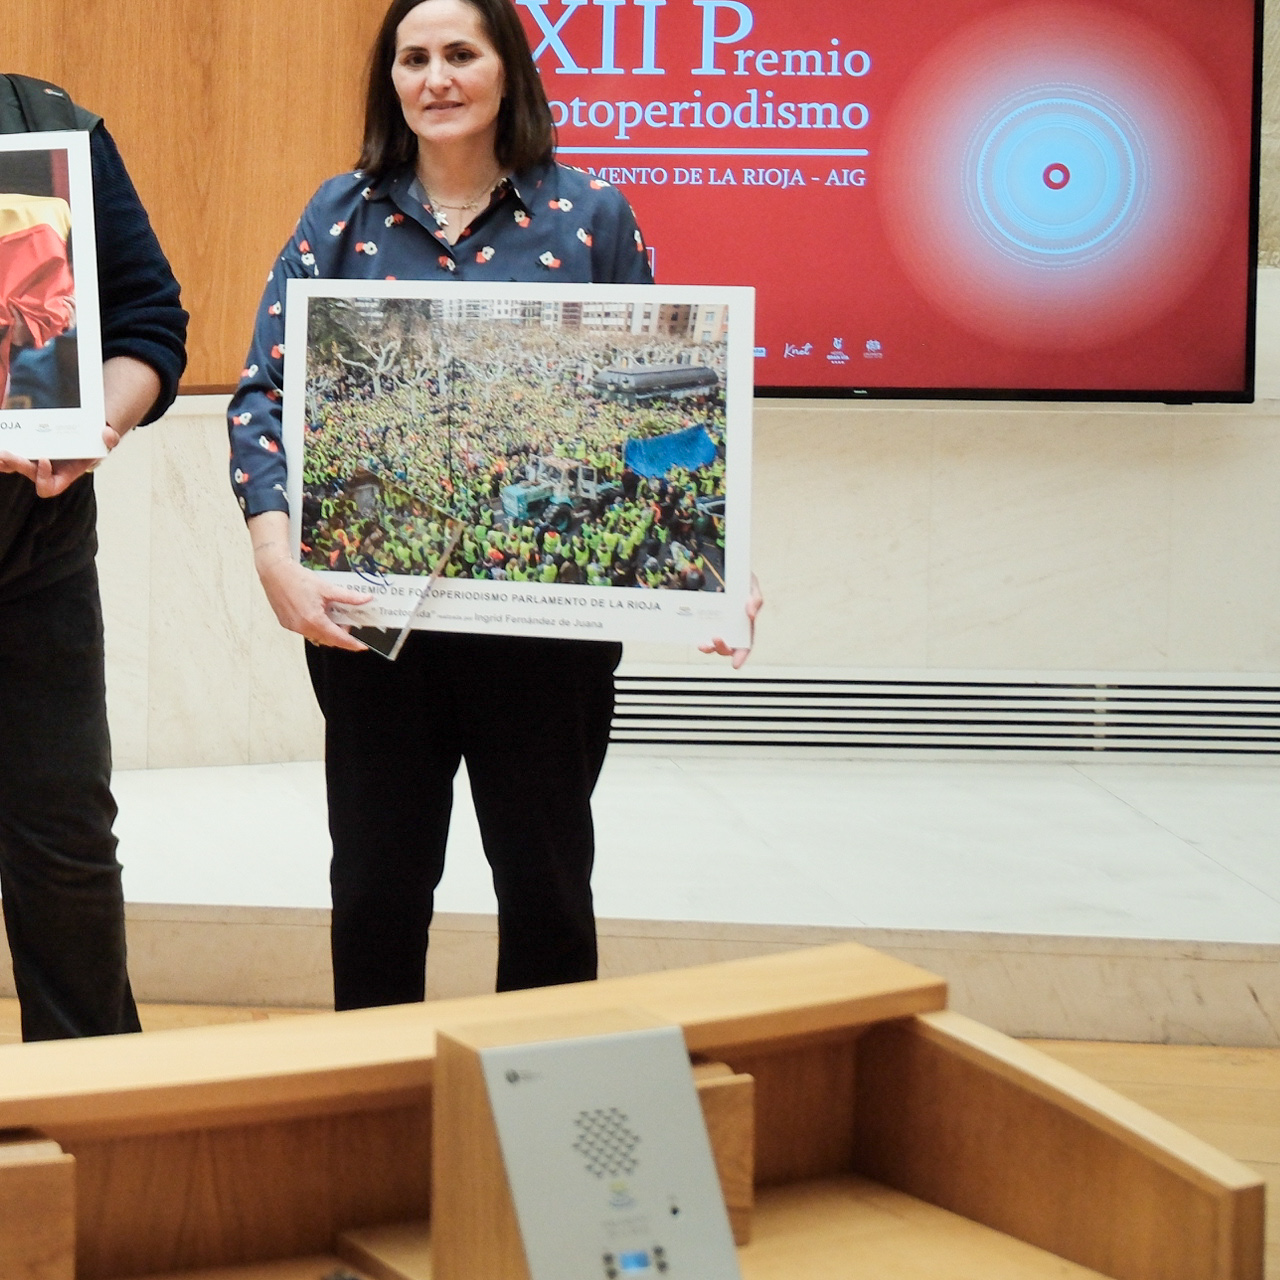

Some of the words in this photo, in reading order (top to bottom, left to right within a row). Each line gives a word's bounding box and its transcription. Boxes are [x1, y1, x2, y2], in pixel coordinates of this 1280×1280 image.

[515, 0, 667, 75] XII
[691, 0, 871, 76] Premio
[549, 89, 870, 140] otoperiodismo
[587, 167, 668, 185] MENTO
[673, 167, 702, 185] DE
[709, 168, 735, 186] LA
[742, 168, 806, 189] RIOJA
[825, 169, 866, 186] AIG
[391, 588, 404, 596] DE
[512, 595, 586, 606] PARLAMENTO
[591, 599, 605, 608] DE
[610, 600, 624, 608] LA
[627, 601, 662, 610] RIOJA
[475, 613, 502, 624] Ingrid
[573, 620, 604, 628] Juana
